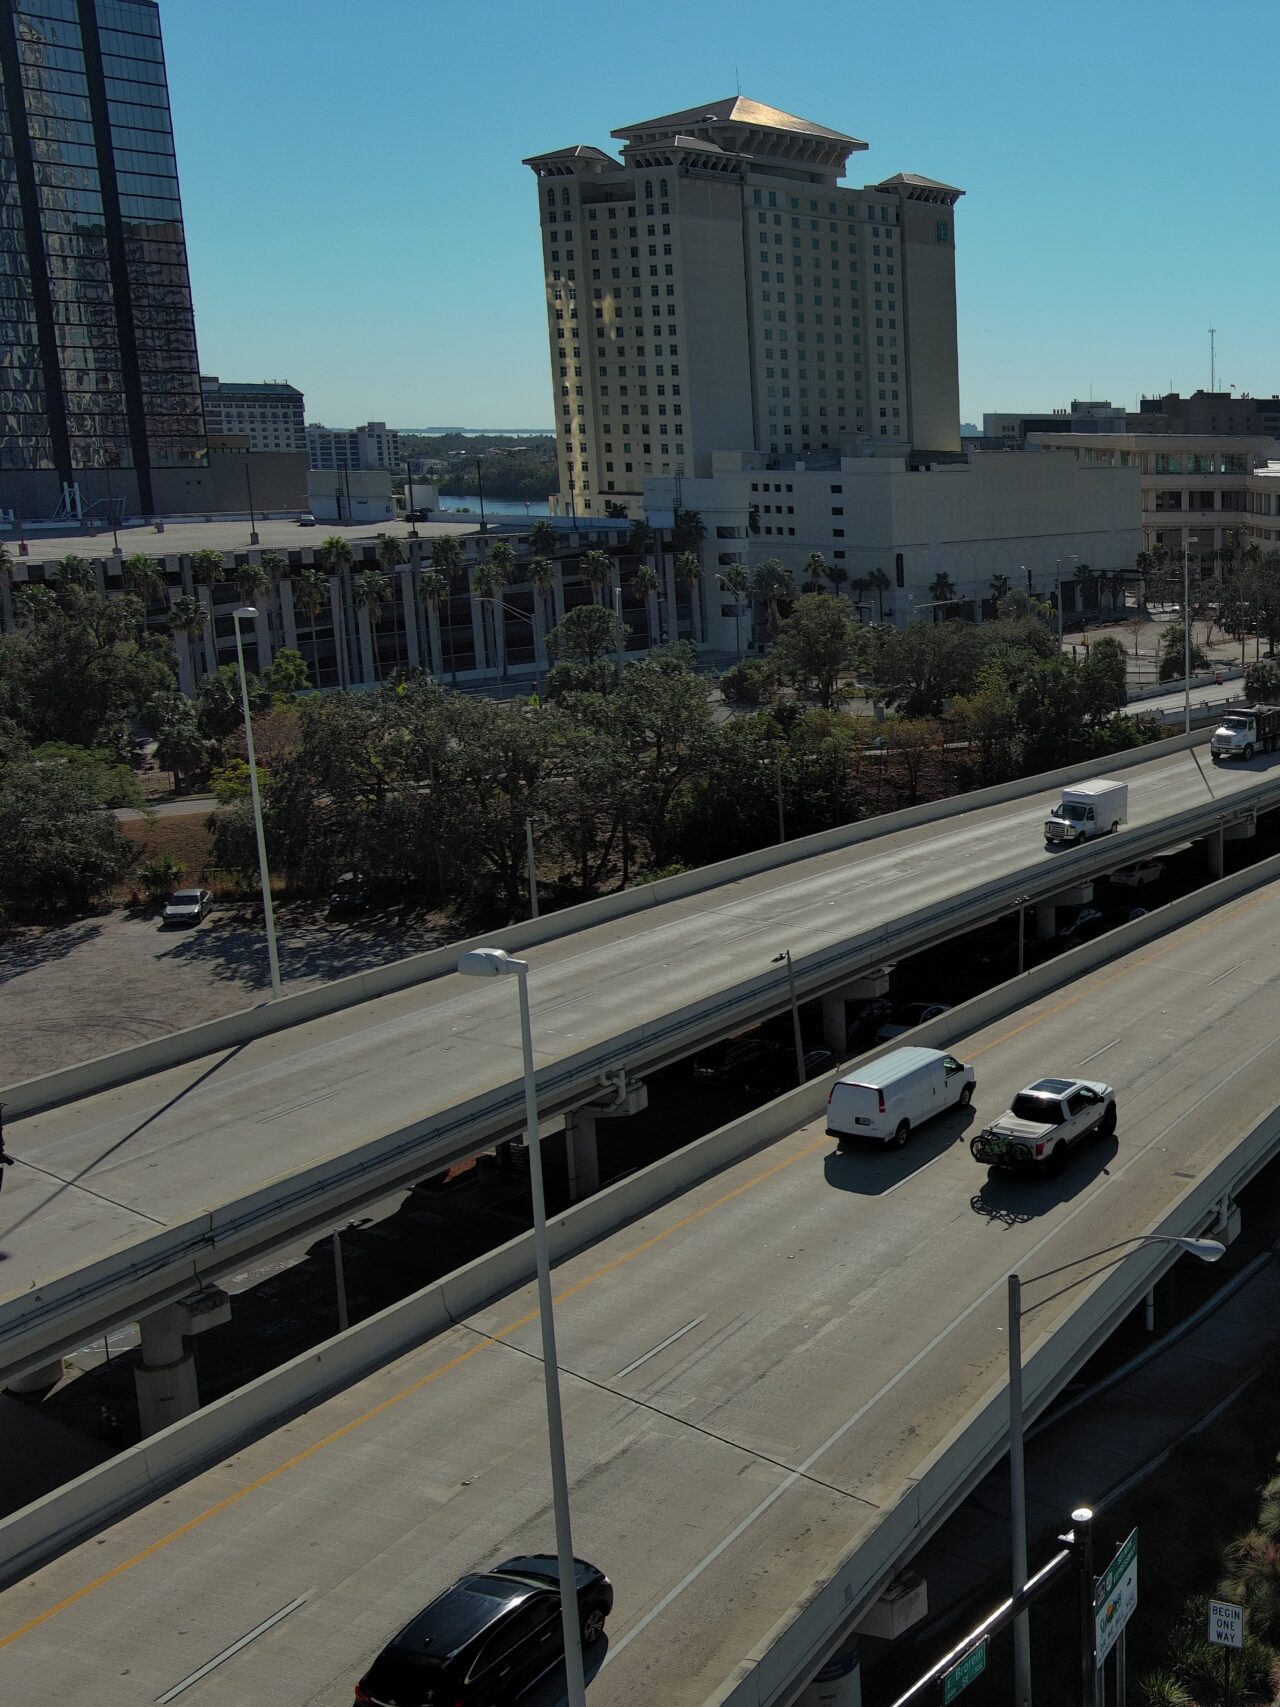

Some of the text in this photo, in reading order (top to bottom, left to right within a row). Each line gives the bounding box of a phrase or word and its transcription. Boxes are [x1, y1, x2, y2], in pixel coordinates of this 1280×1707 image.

[1212, 1606, 1241, 1620] BEGIN
[1217, 1618, 1236, 1631] ONE
[1216, 1630, 1235, 1643] WAY
[955, 1648, 983, 1681] Brorein
